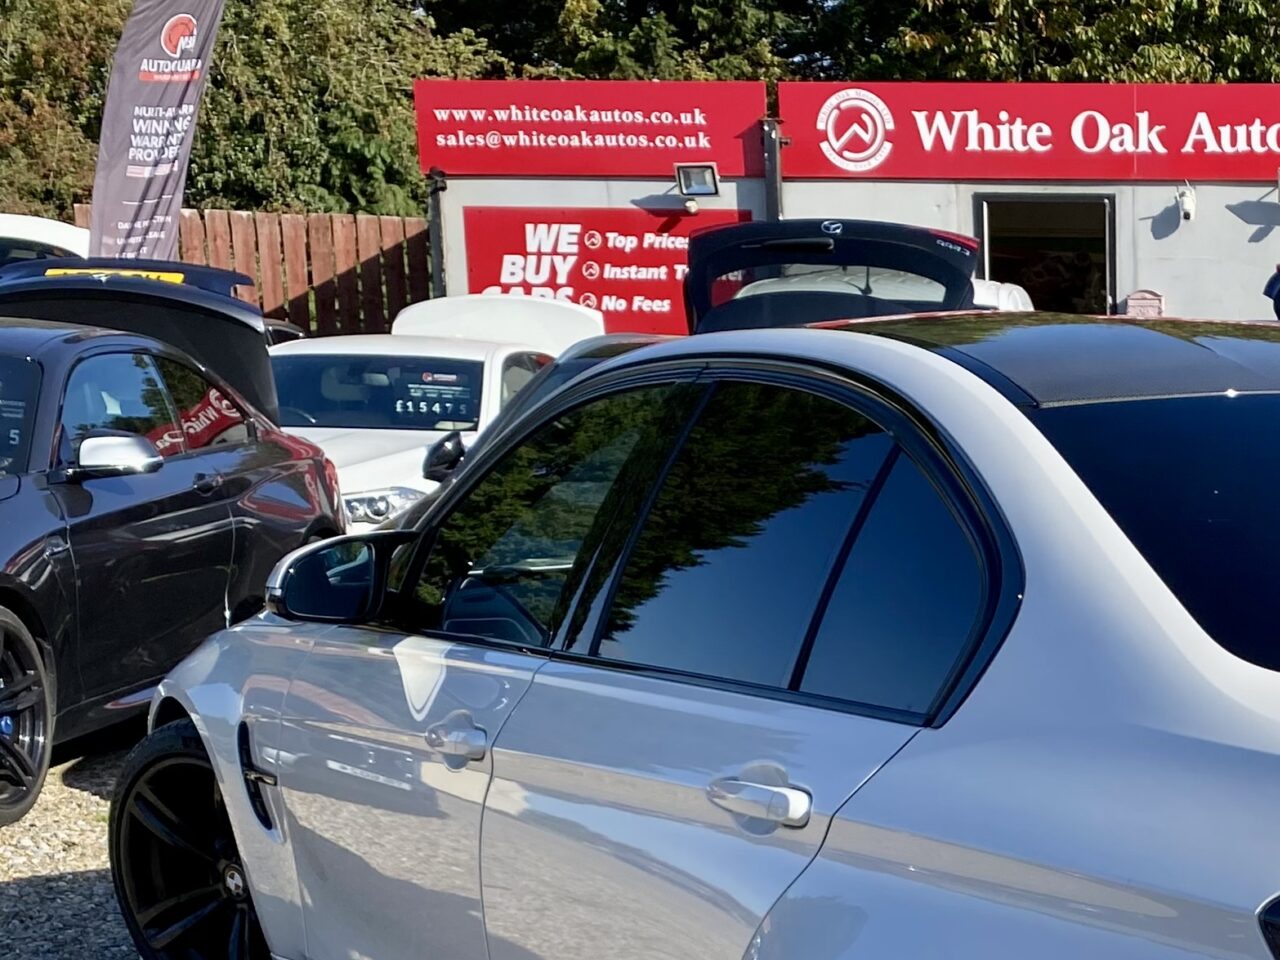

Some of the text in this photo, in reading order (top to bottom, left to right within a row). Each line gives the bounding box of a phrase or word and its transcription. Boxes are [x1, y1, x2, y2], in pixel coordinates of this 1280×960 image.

[433, 105, 707, 125] www.whiteoakautos.co.uk
[436, 130, 711, 149] sales@whiteoakautos.co.uk
[911, 109, 1053, 152] White
[1070, 109, 1168, 153] Oak
[525, 223, 581, 253] WE
[606, 232, 637, 253] Top
[500, 254, 578, 285] BUY
[603, 264, 668, 280] Instant
[602, 296, 671, 312] No Fees
